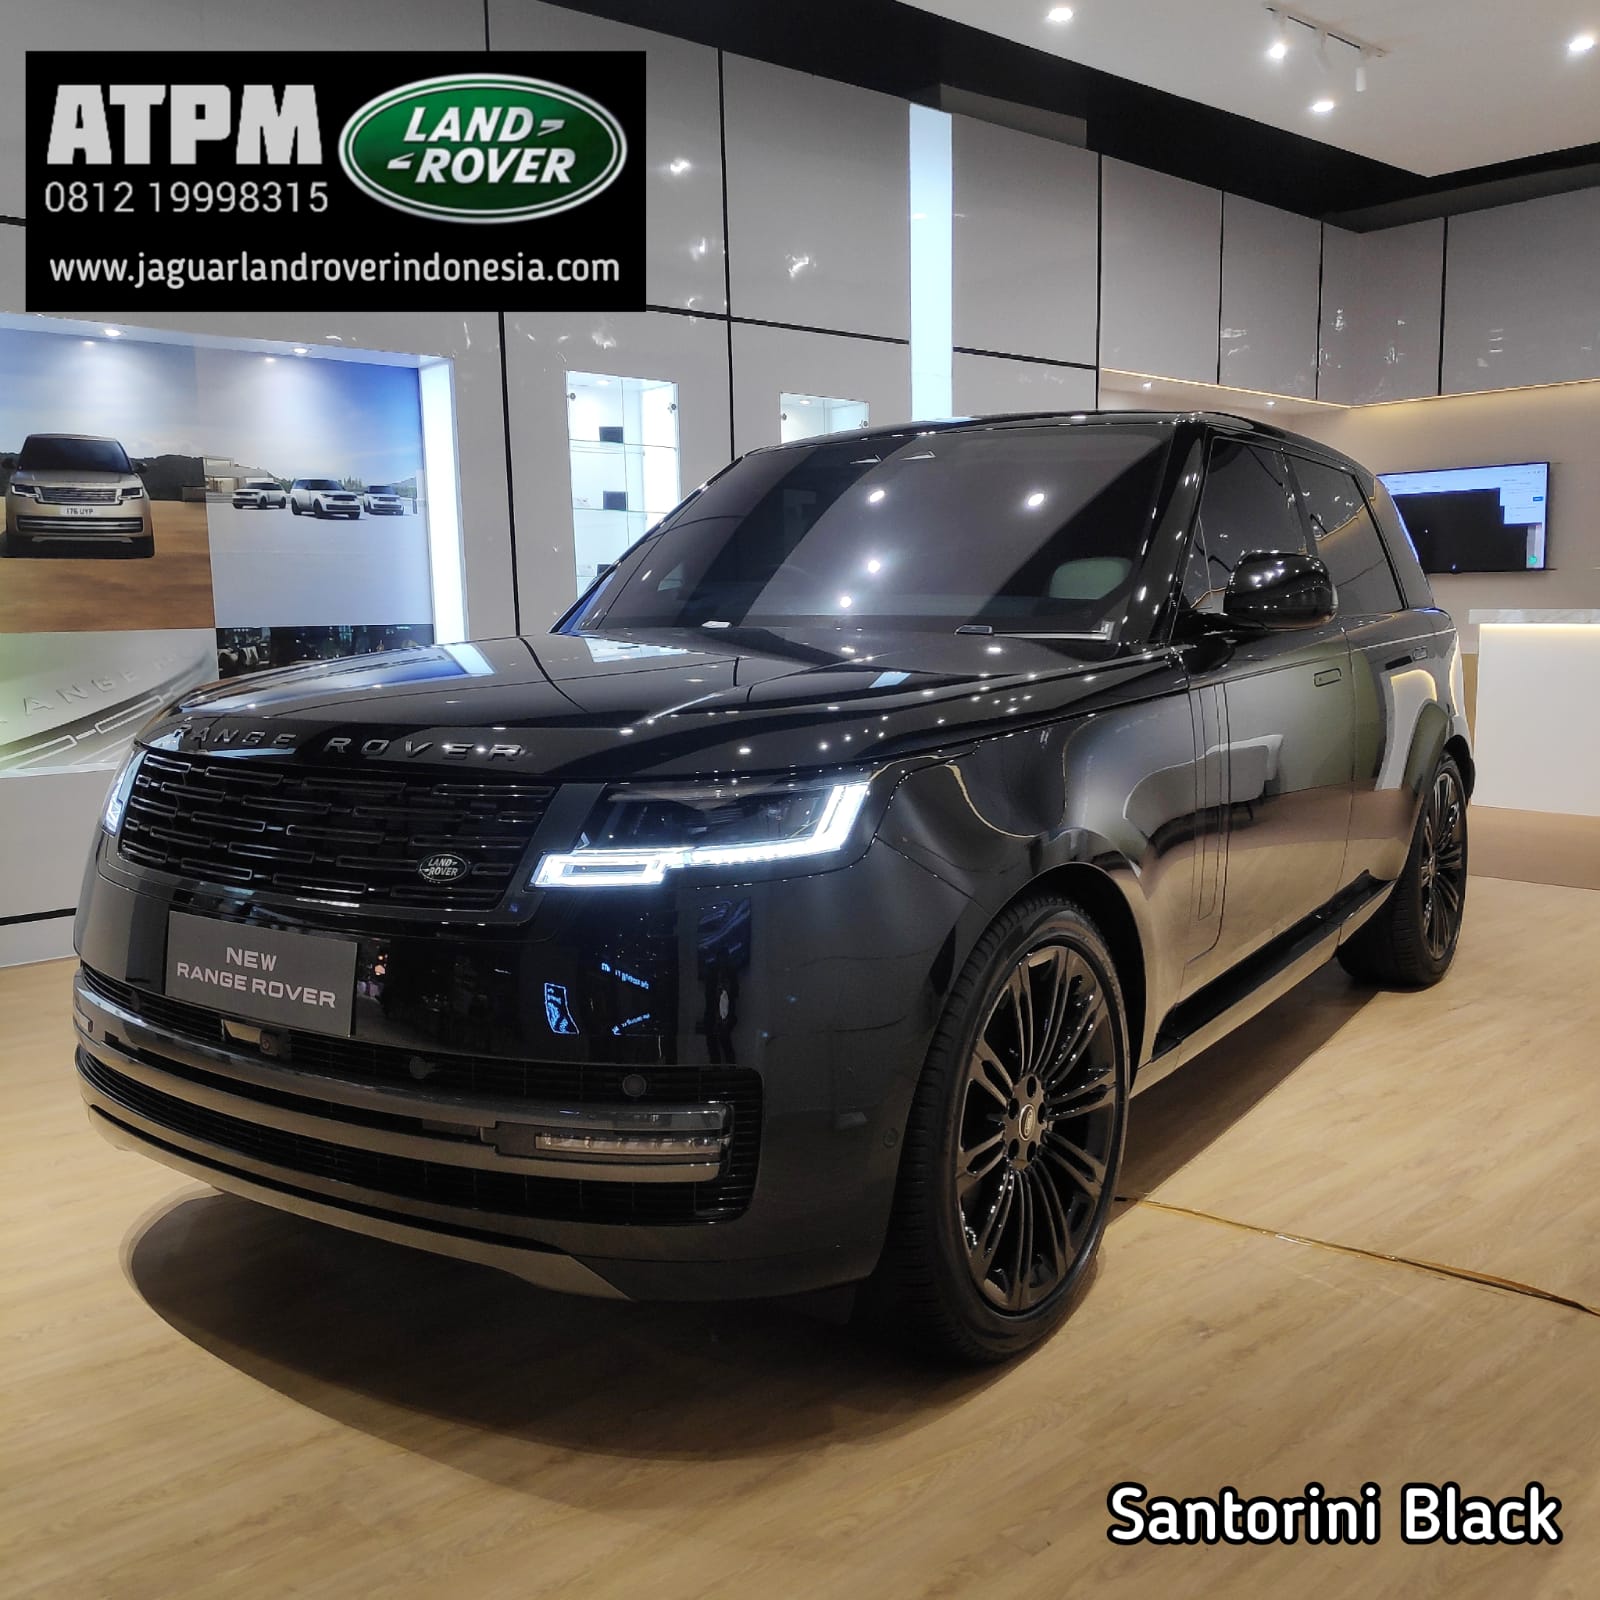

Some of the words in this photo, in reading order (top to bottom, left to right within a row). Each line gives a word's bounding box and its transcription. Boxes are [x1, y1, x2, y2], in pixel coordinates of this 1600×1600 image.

[0, 671, 138, 724] ANGE
[173, 724, 297, 747] RANGE
[324, 736, 528, 761] ROVER
[427, 866, 459, 877] ROVER
[428, 858, 453, 867] LAND
[225, 946, 278, 973] NEW
[176, 962, 248, 991] RANGE
[251, 977, 337, 1009] ROVER
